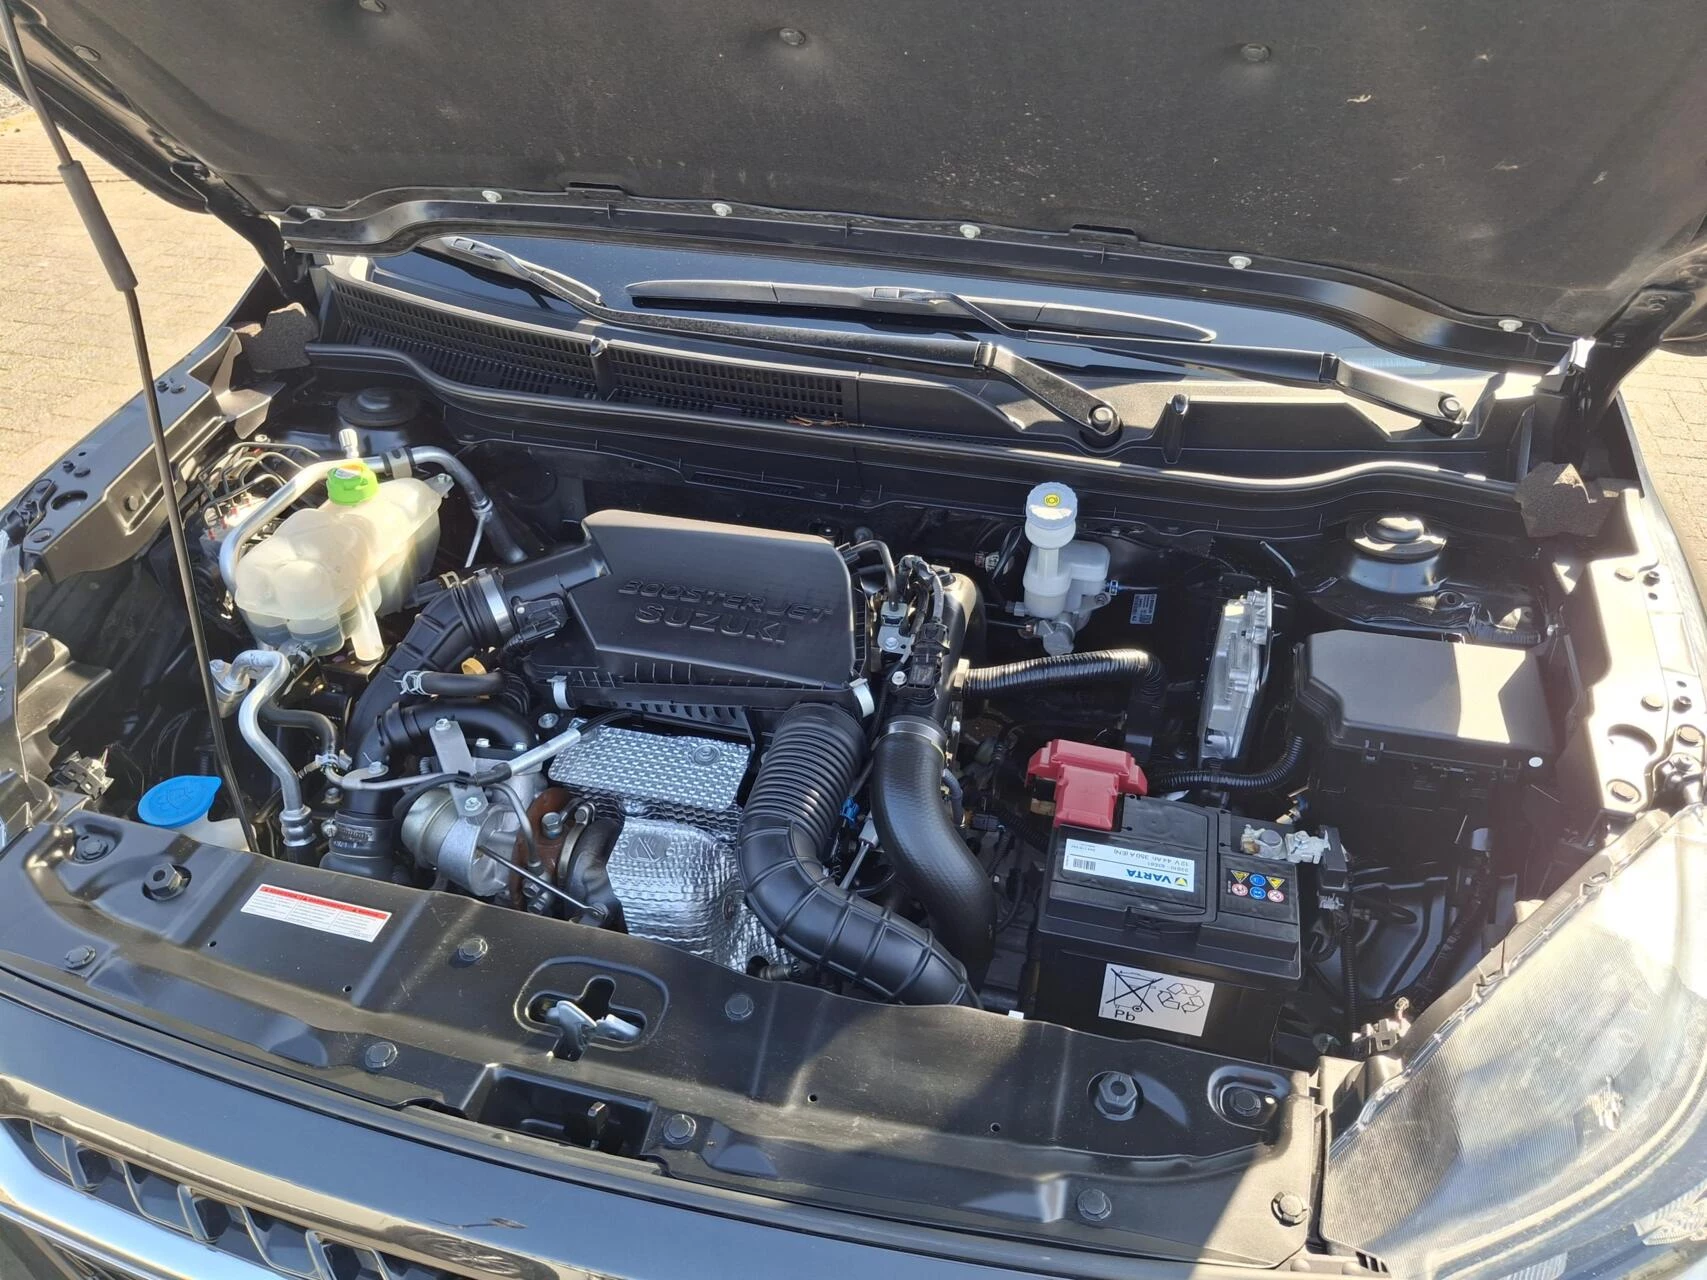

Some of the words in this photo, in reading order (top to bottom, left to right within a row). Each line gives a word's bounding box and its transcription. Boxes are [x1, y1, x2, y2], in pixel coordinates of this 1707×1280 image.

[635, 602, 785, 644] SUZUKI
[1126, 868, 1171, 883] VARTA
[1114, 1009, 1135, 1022] Pb
